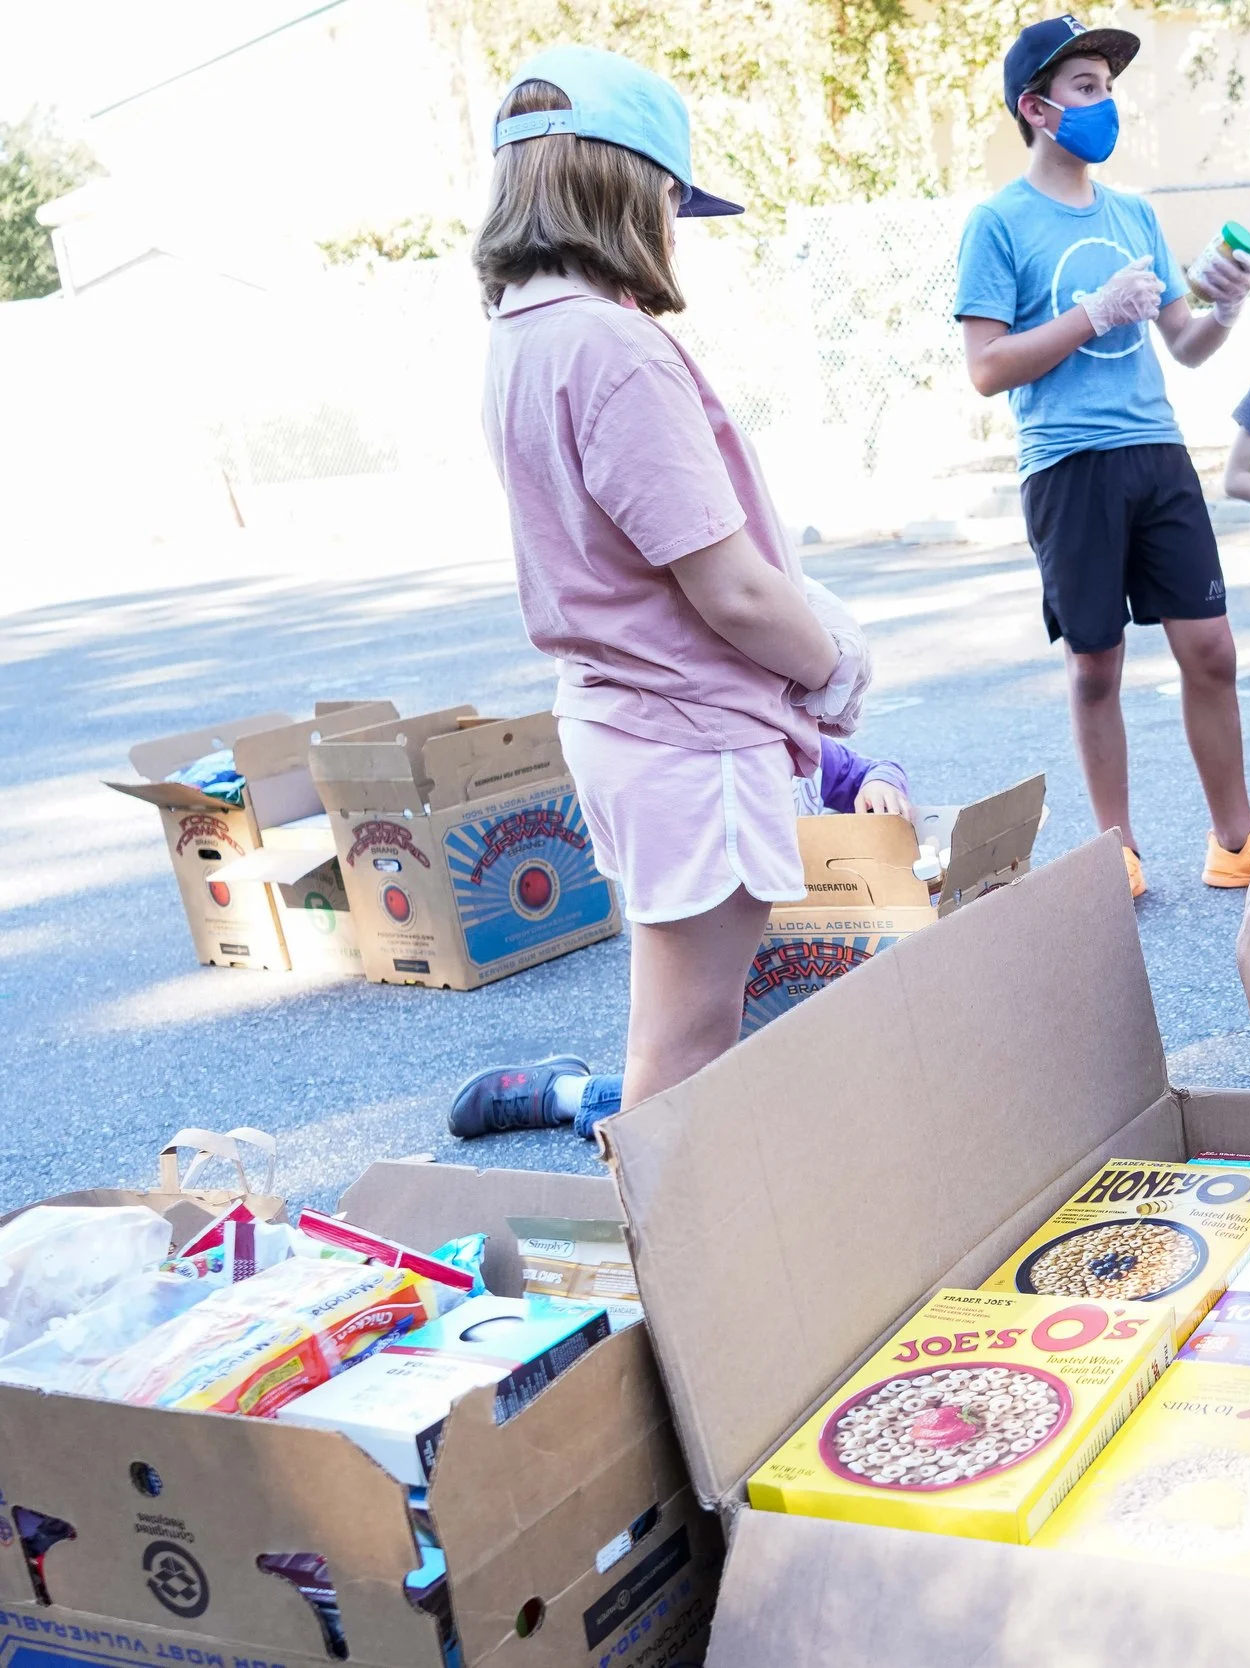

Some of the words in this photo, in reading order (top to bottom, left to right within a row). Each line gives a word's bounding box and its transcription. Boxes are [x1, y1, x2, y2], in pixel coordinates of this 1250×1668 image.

[485, 803, 497, 813] TO
[500, 797, 525, 809] LOCAL
[529, 783, 571, 801] AGENCIES
[178, 814, 229, 834] FOOD
[352, 820, 413, 841] FOOD
[482, 809, 564, 848] FOOD
[176, 825, 246, 857] FORWARD
[346, 832, 431, 869] FORWARD
[370, 846, 399, 856] BRAND
[507, 839, 546, 858] BRAND
[470, 823, 586, 886] FORWARD
[779, 921, 821, 931] LOCAL
[826, 920, 895, 930] AGENCIES
[478, 961, 516, 980] SERVING
[518, 952, 537, 964] OUR
[745, 960, 850, 1000] ORWA
[787, 984, 827, 996] BRA
[1074, 1170, 1204, 1204] HONEY
[1189, 1208, 1228, 1221] Toasted
[1201, 1220, 1227, 1232] Grain
[1228, 1222, 1250, 1233] Oats
[1214, 1228, 1243, 1241] Cereal
[312, 1281, 376, 1317] Marucha
[943, 1295, 982, 1304] TRADER
[984, 1298, 1014, 1307] JOE'S
[892, 1328, 1027, 1363] JOE'S
[199, 1339, 271, 1392] Marucha
[1046, 1354, 1087, 1366] Toasted
[1088, 1356, 1124, 1366] Whole
[1060, 1365, 1091, 1376] Grain
[1092, 1366, 1116, 1376] Oats
[1075, 1376, 1110, 1386] Cereal
[1162, 1401, 1211, 1415] Yours
[0, 1610, 149, 1654] VULNERABLE
[155, 1641, 225, 1667] MOST
